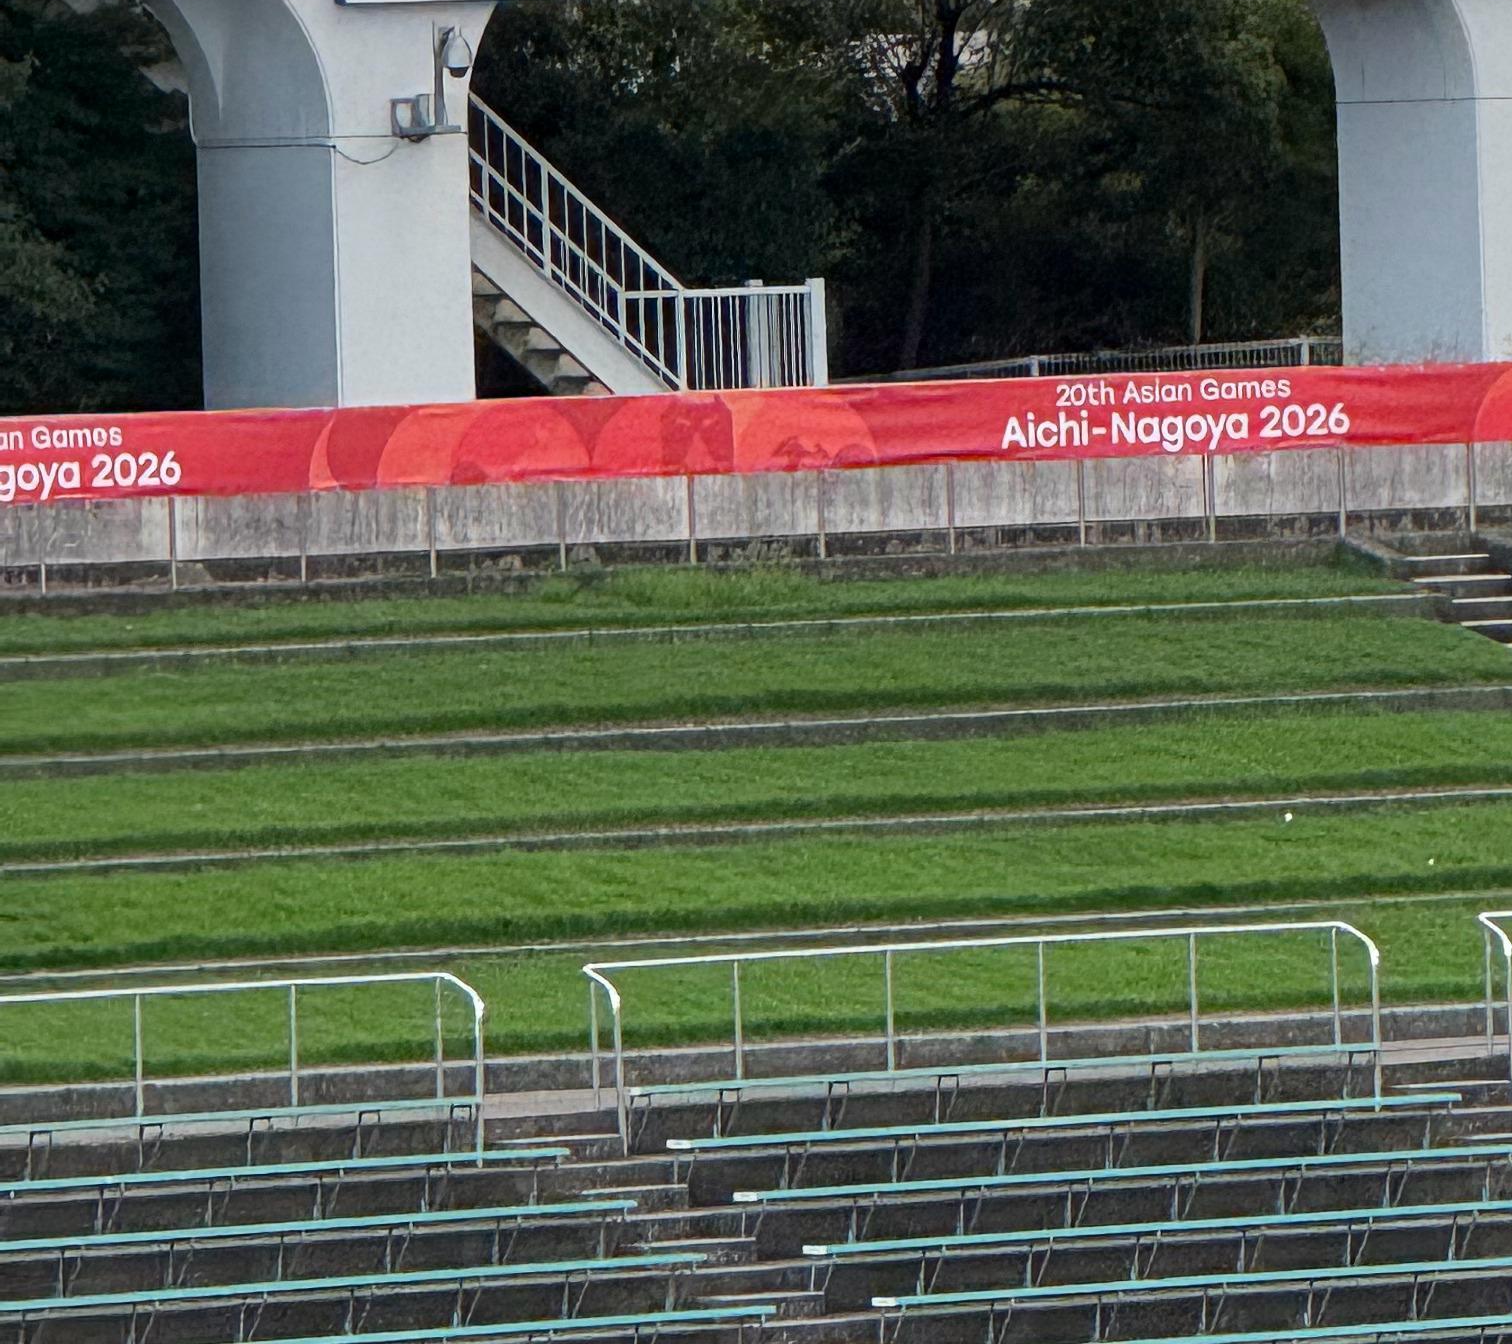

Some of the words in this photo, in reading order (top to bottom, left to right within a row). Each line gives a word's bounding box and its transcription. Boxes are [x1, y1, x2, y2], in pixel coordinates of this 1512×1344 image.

[1055, 382, 1115, 407] 20th
[1122, 377, 1192, 404] Asian
[1199, 376, 1291, 401] Games
[31, 425, 123, 450] Games
[1001, 409, 1249, 452] Aichi-Nagoya
[1259, 402, 1351, 438] 2026
[91, 450, 182, 488] 2026
